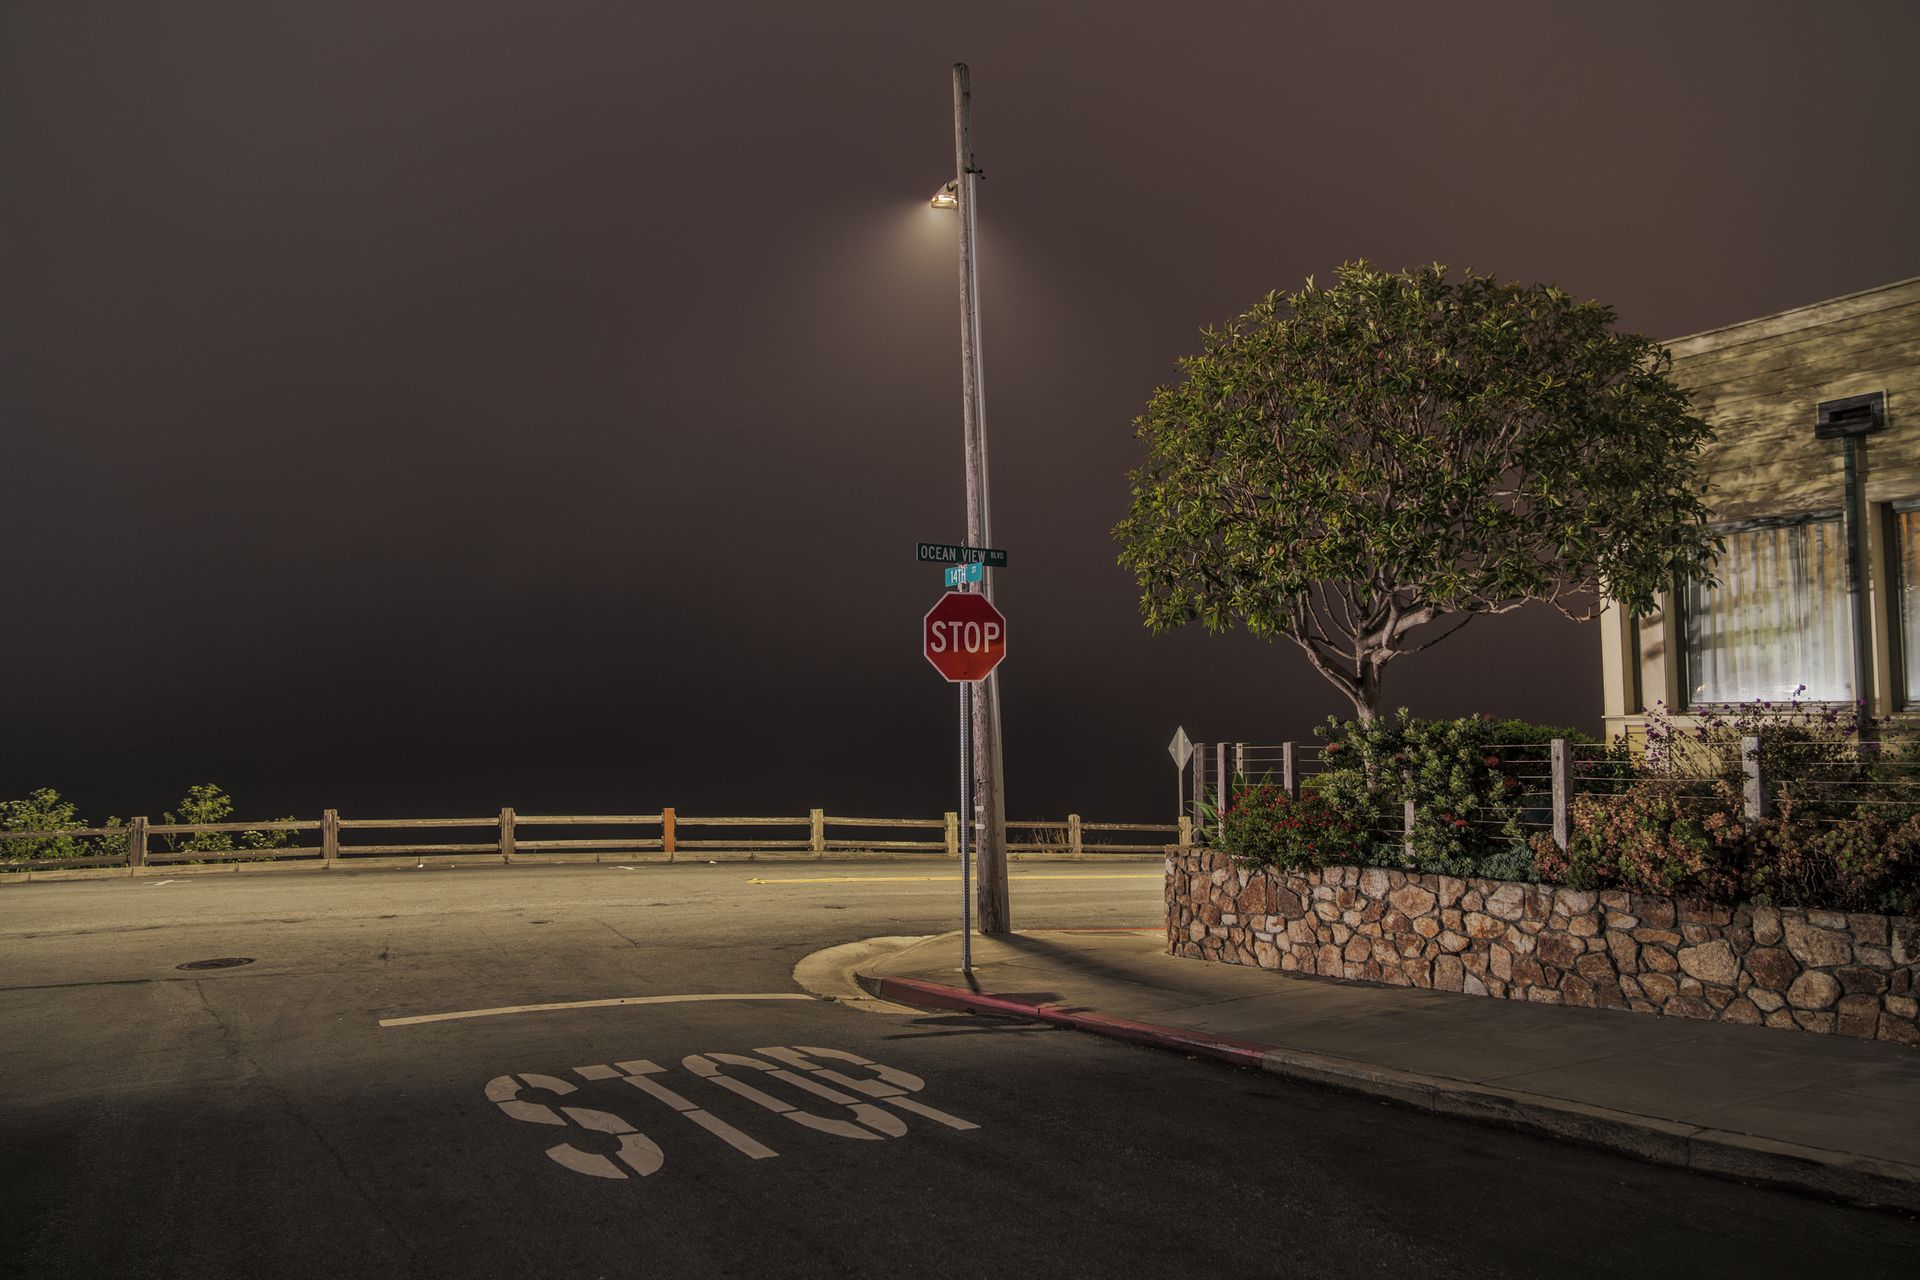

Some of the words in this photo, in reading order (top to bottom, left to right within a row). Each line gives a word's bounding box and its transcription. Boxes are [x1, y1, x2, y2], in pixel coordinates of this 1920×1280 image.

[920, 545, 956, 561] OCEAN
[961, 549, 986, 563] VIEW
[990, 551, 1004, 559] BLVD
[930, 620, 1000, 653] STOP
[484, 1045, 982, 1180] STOP
